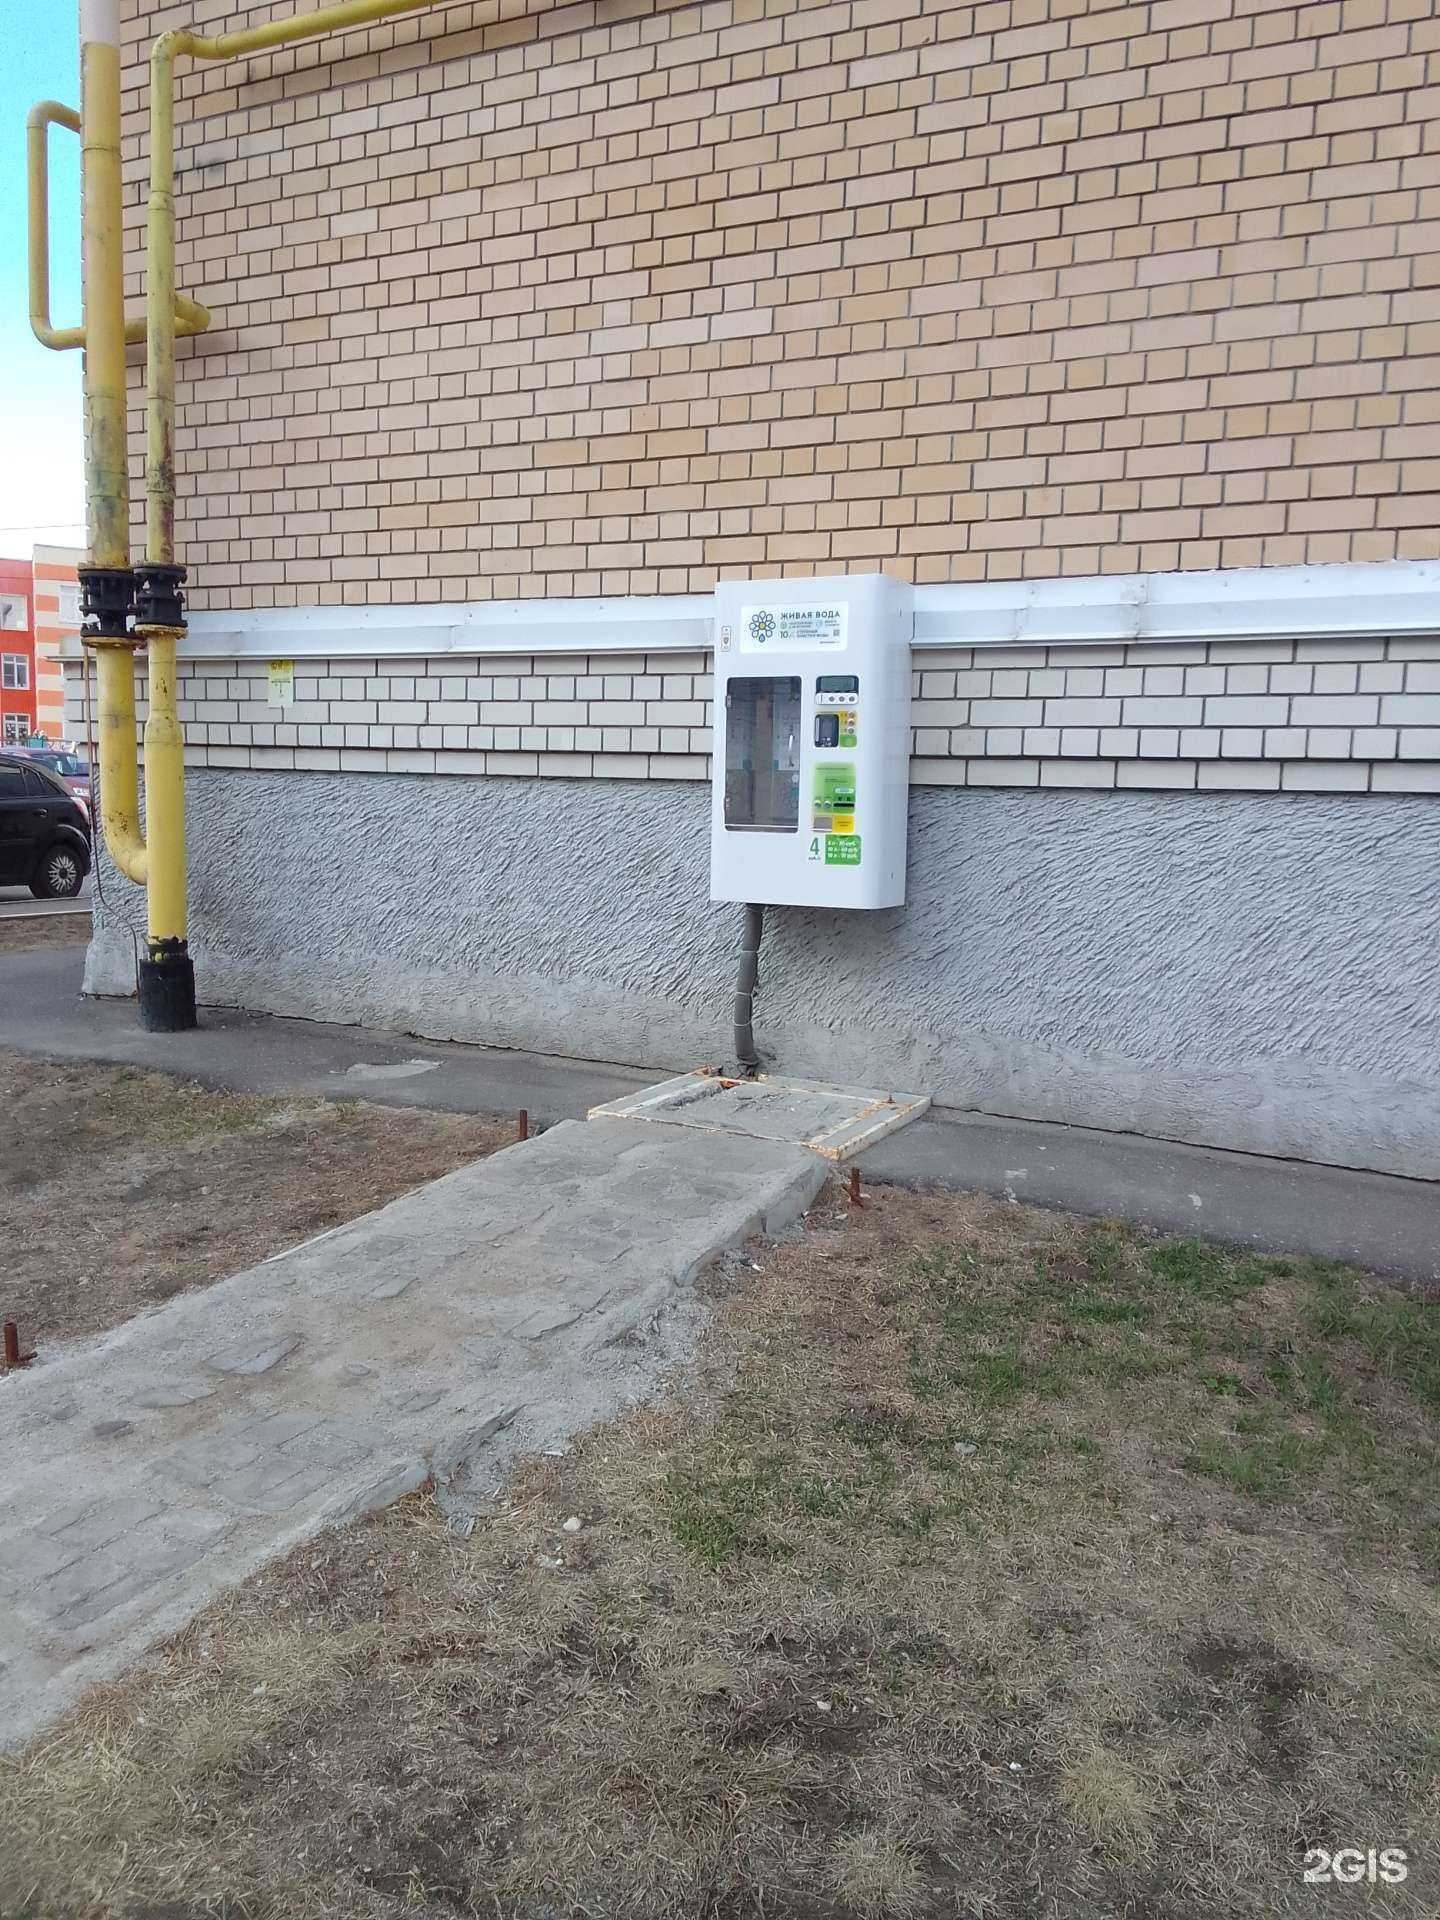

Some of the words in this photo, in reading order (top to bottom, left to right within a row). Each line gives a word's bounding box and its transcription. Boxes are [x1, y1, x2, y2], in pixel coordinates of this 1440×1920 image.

[780, 612, 812, 620] ЖИВАЯ
[815, 611, 840, 619] ВОДА
[810, 837, 819, 855] 4
